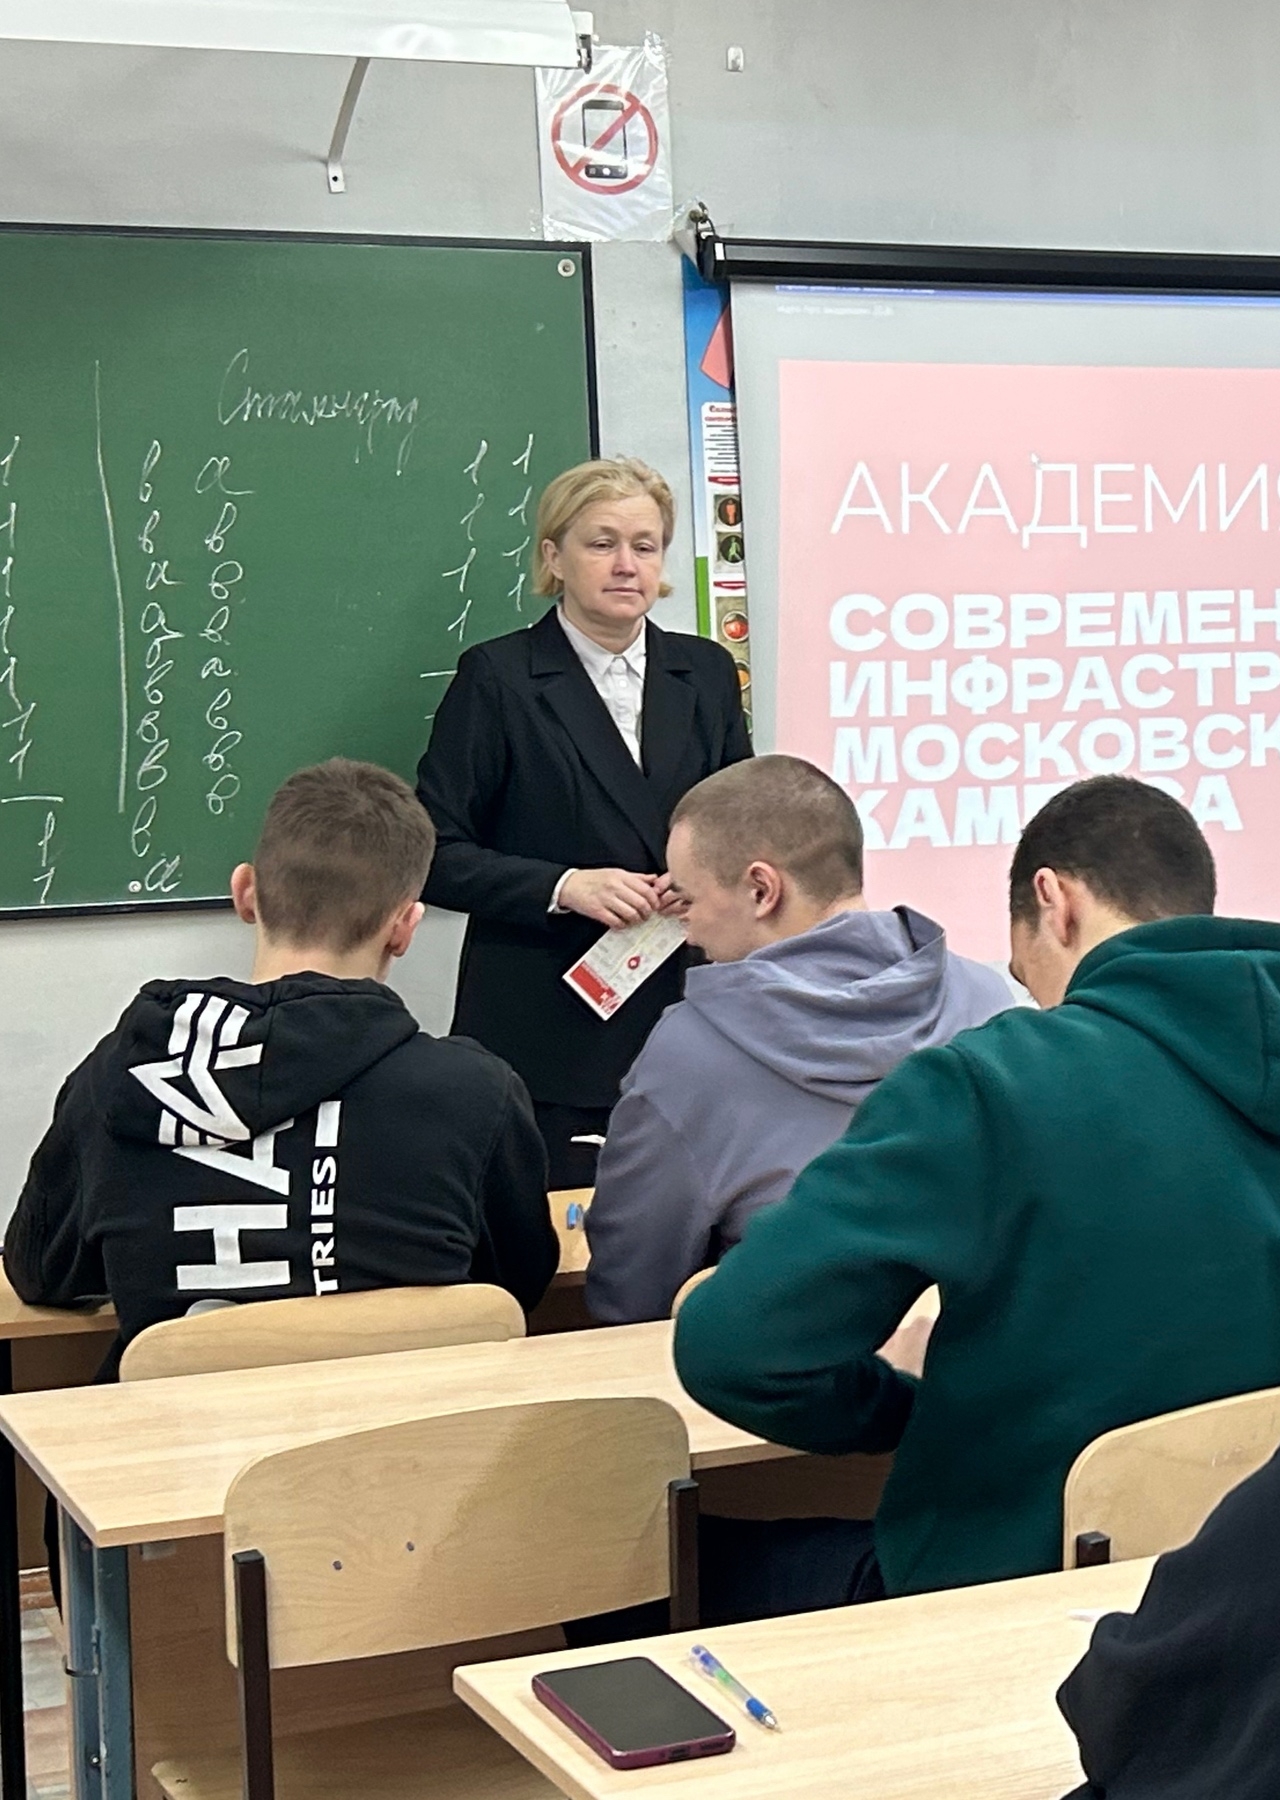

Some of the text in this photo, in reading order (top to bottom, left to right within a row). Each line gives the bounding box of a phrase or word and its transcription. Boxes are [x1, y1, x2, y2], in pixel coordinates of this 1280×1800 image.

[855, 774, 1244, 851] КАМА
[172, 1117, 294, 1317] HA
[311, 1155, 338, 1296] TRIES
